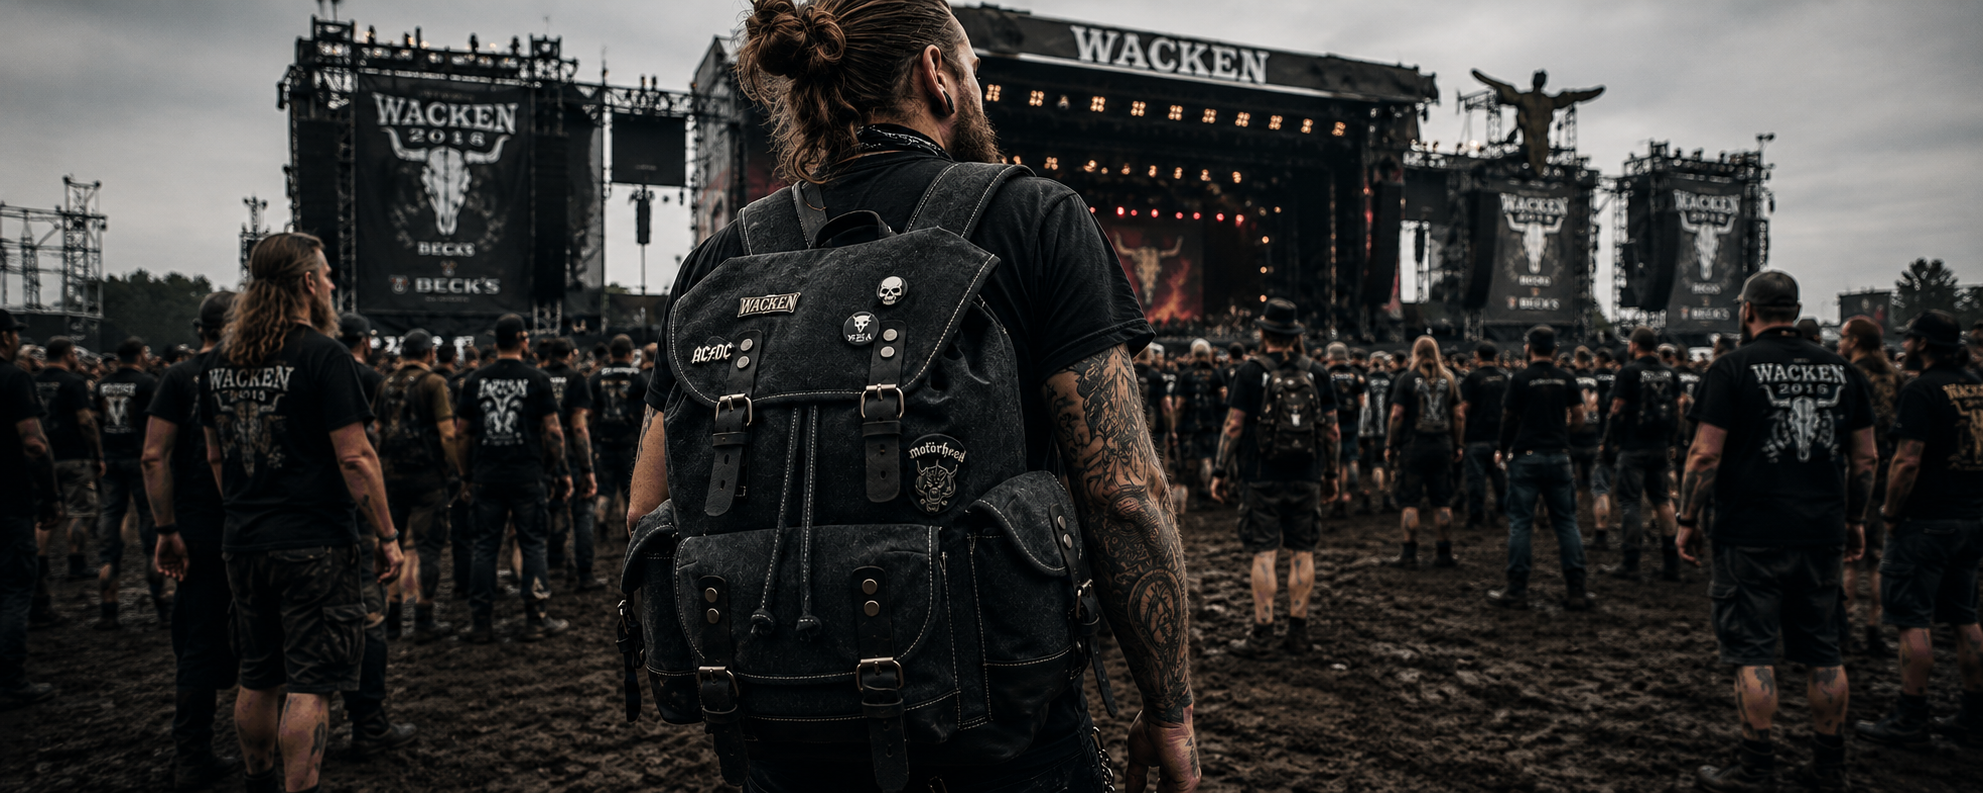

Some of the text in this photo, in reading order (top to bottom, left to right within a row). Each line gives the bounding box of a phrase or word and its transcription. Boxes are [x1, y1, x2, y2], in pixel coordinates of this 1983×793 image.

[1070, 24, 1270, 84] WACKEN
[371, 92, 519, 134] WACKEN
[415, 275, 501, 295] BECK'S
[740, 294, 798, 315] WACKEN
[208, 365, 295, 392] WACKEN
[1749, 362, 1847, 385] WACKEN
